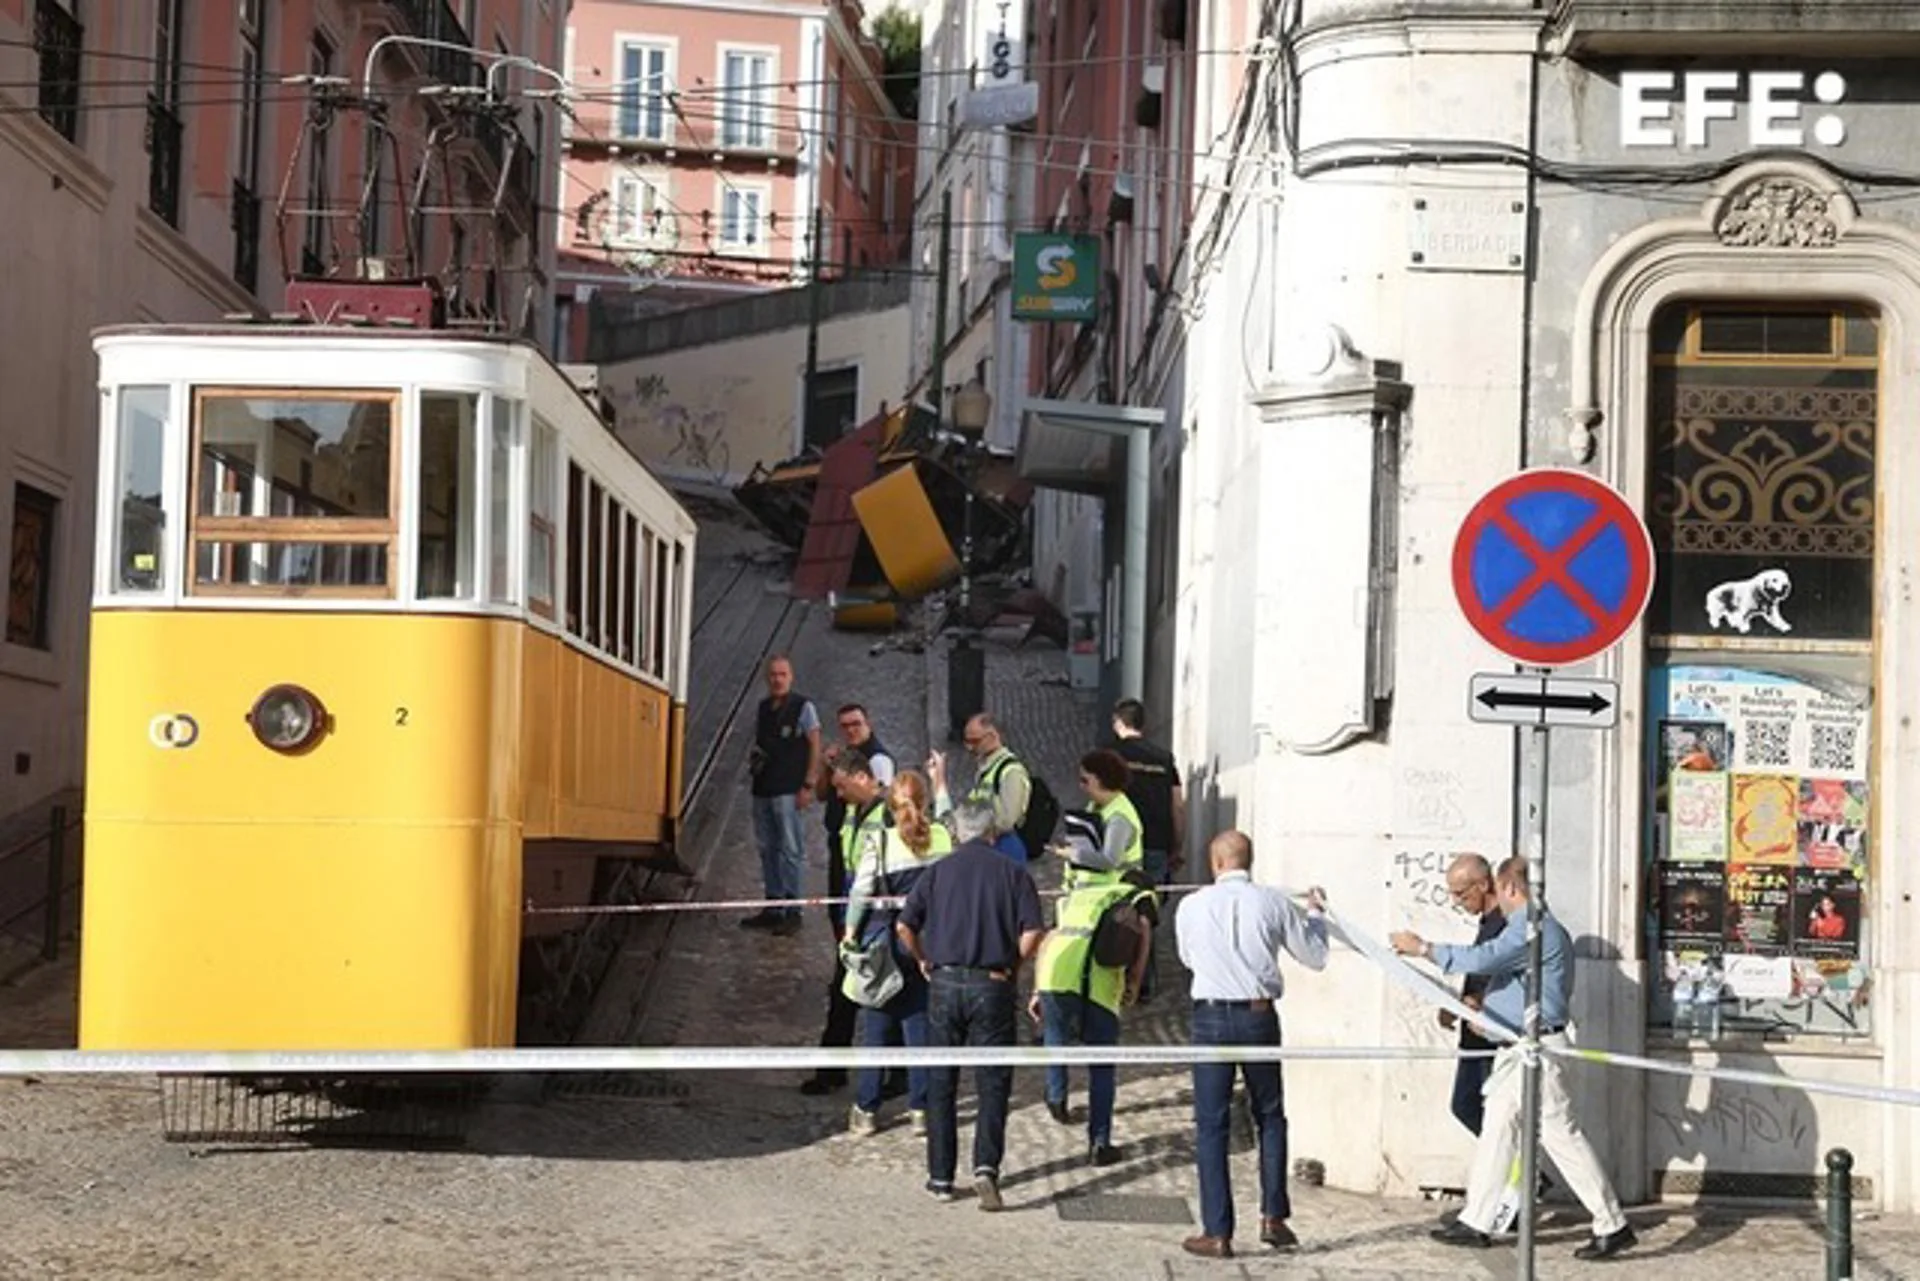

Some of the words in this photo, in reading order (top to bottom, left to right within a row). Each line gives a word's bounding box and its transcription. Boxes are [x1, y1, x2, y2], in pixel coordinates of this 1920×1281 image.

[1017, 296, 1093, 312] SUBWAY
[1741, 695, 1797, 709] Redesign
[395, 707, 409, 726] 2
